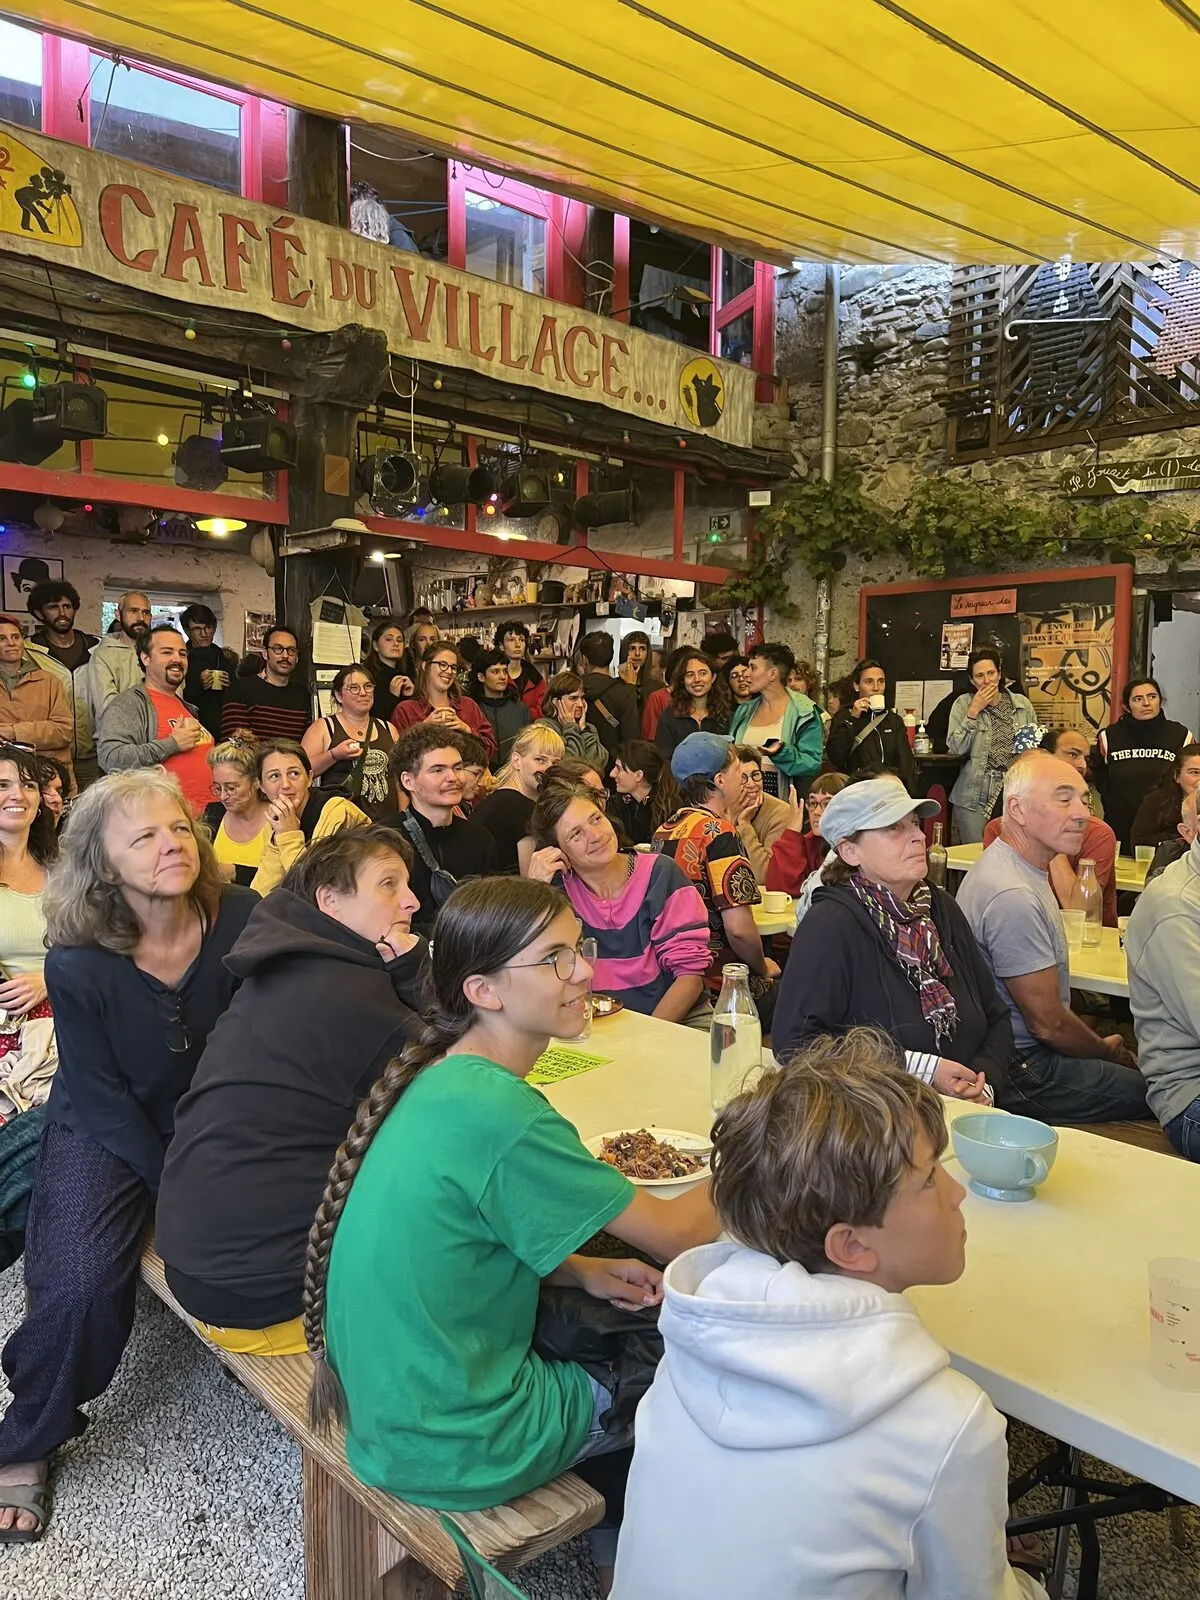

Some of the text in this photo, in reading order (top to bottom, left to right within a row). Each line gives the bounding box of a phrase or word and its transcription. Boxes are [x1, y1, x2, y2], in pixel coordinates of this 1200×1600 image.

[98, 183, 312, 308] CAFÉ
[327, 257, 378, 310] DU
[1047, 621, 1087, 631] ENVIE DE
[1111, 748, 1176, 762] THE KOOPLES
